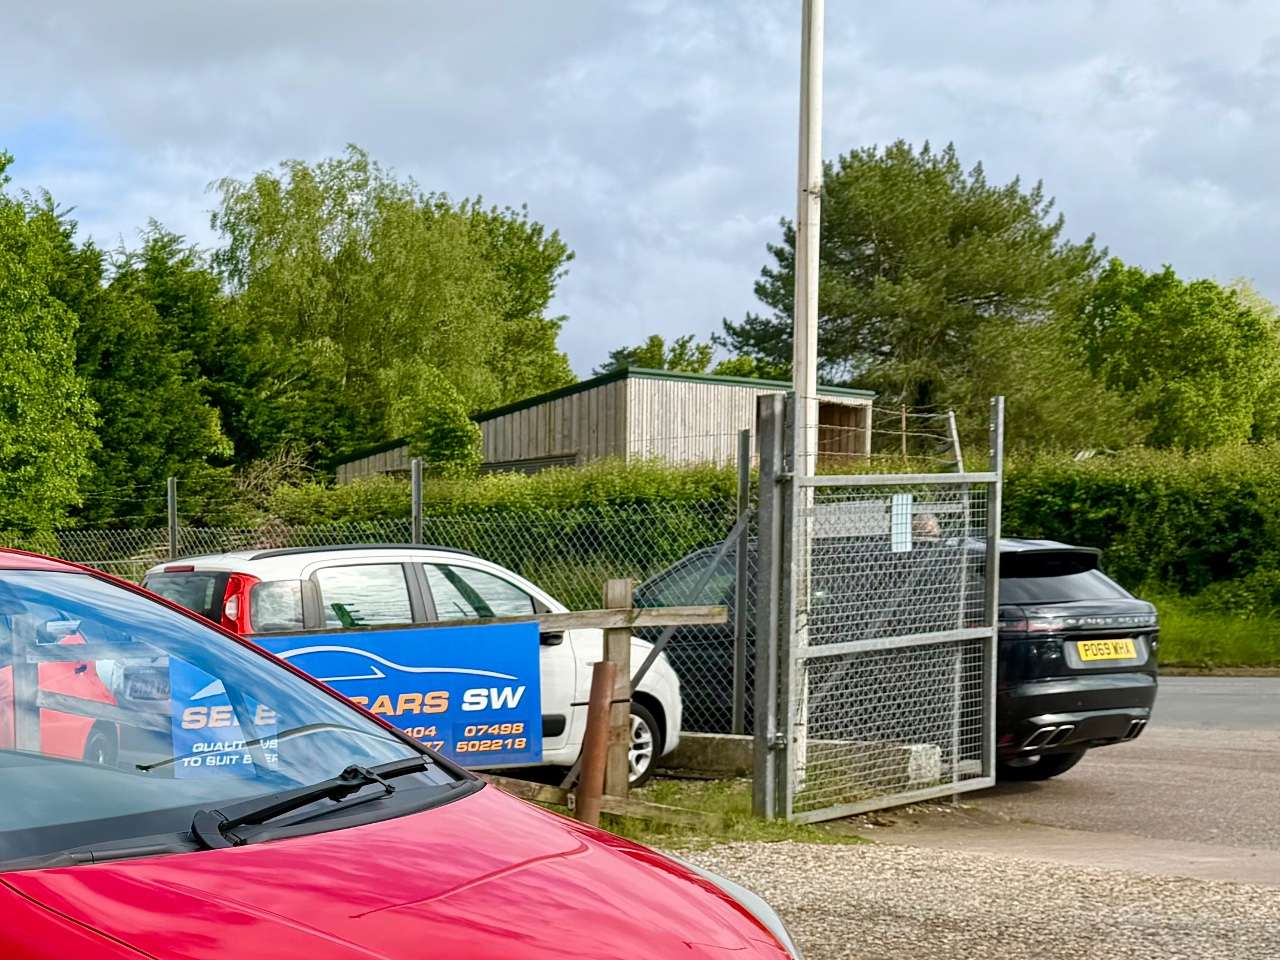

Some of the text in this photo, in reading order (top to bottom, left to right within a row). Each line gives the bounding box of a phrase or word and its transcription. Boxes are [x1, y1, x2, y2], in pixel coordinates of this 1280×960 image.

[462, 686, 526, 712] SW
[404, 726, 437, 738] 404
[464, 723, 524, 737] 07498
[192, 740, 246, 752] QUALIT
[456, 738, 527, 753] 502218
[183, 757, 202, 767] TO
[206, 755, 239, 766] SUIT
